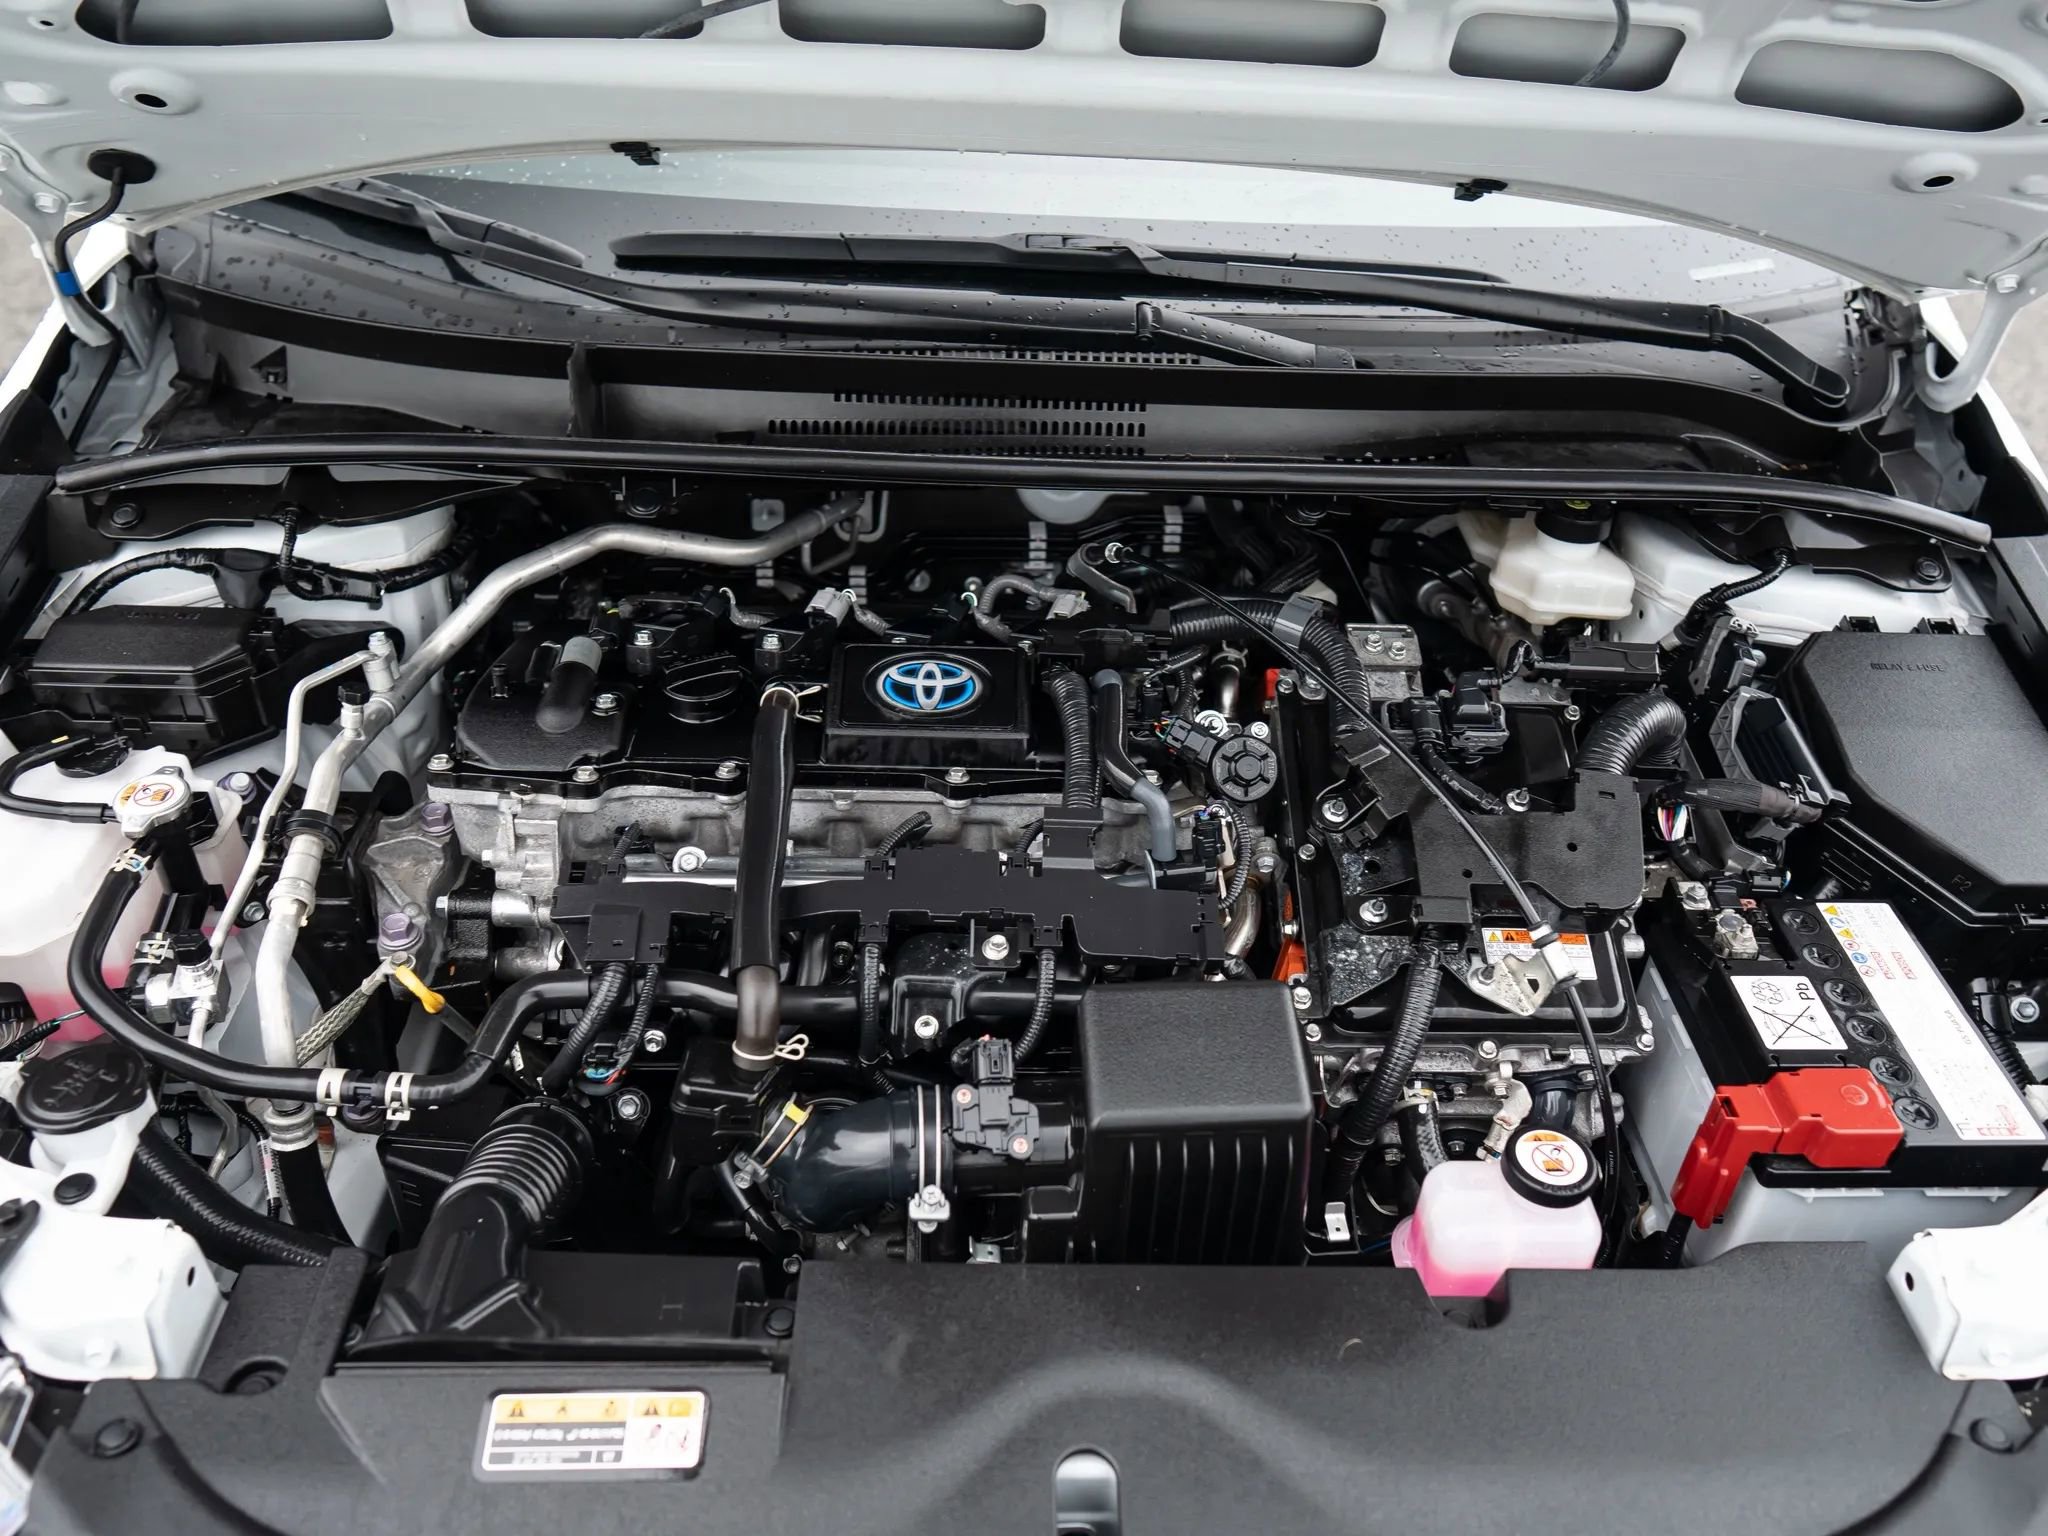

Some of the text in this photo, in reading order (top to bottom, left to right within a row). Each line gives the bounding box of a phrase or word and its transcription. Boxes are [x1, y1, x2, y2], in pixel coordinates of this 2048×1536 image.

[1870, 662, 1903, 672] RELAY
[1916, 662, 1945, 672] FUSE
[1795, 982, 1816, 1001] Pb
